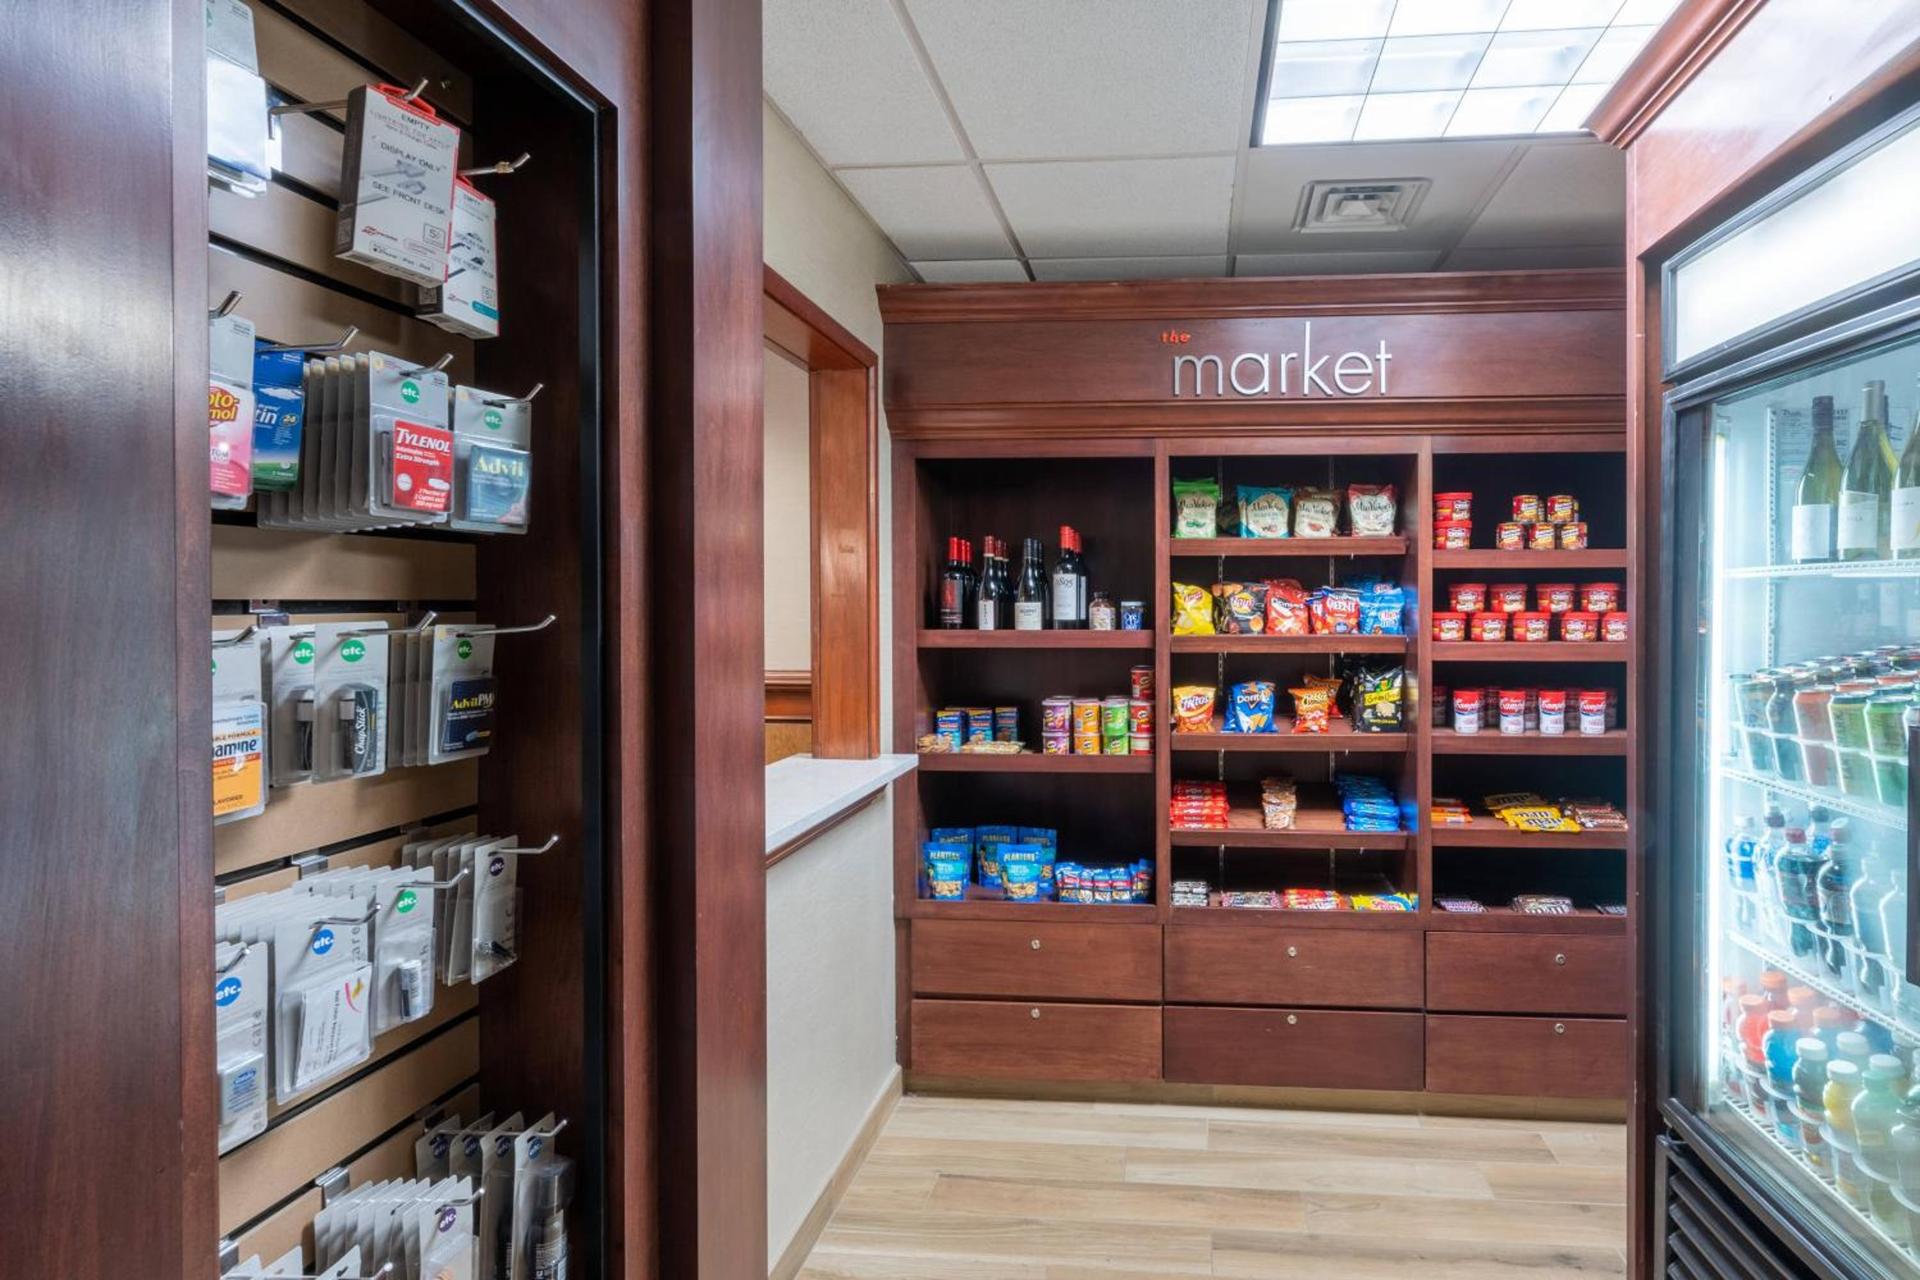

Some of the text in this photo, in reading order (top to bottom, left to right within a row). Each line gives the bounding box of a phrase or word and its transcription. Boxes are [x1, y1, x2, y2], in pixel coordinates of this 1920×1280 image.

[380, 141, 441, 173] DISPLAY ONLY
[372, 181, 445, 215] SEE FRONT DESK
[1160, 330, 1191, 345] the
[1172, 320, 1393, 397] market
[396, 427, 451, 453] TYLENOL
[475, 455, 524, 478] Advil
[294, 648, 315, 658] etc.
[342, 646, 365, 656] etc.
[451, 696, 478, 711] Advil
[353, 705, 367, 755] ChapStick
[211, 738, 258, 758] amine
[398, 896, 418, 910] etc.
[313, 935, 335, 950] etc.
[215, 983, 242, 1001] etc.
